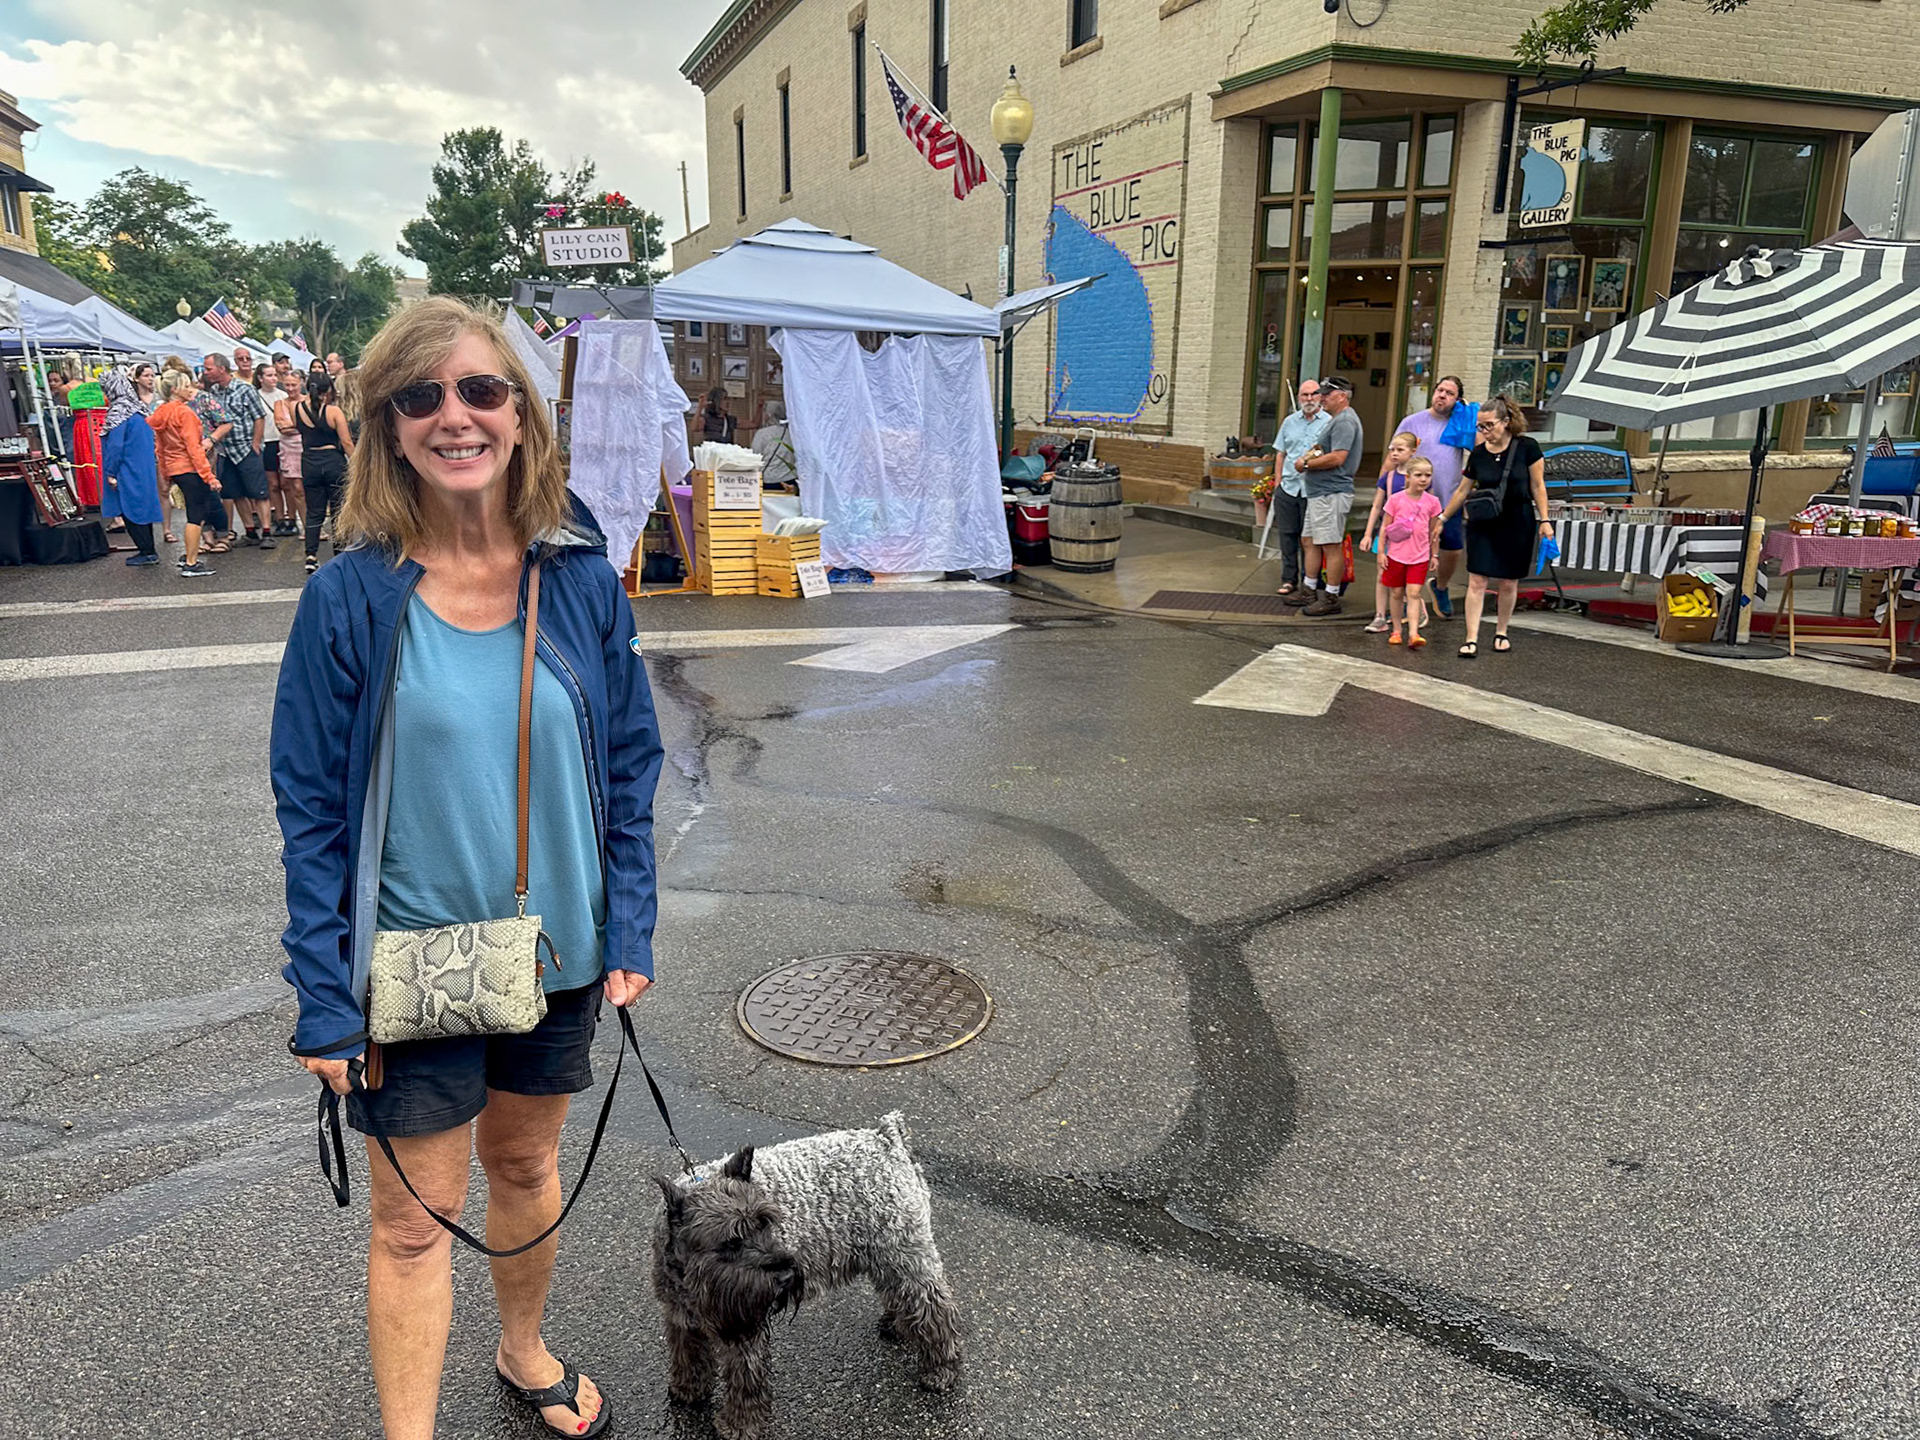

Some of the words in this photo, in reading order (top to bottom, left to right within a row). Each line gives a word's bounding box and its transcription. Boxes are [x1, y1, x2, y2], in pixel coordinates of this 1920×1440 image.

[1532, 126, 1553, 140] THE
[1544, 136, 1569, 151] BLUE
[1560, 148, 1577, 162] PIG
[1062, 141, 1104, 190] THE
[1089, 178, 1142, 230] BLUE
[1521, 207, 1570, 225] GALLERY
[550, 235, 583, 245] LILY
[586, 233, 621, 244] CAIN
[1140, 220, 1177, 262] PIG
[552, 246, 623, 261] STUDIO
[737, 475, 758, 486] Bags
